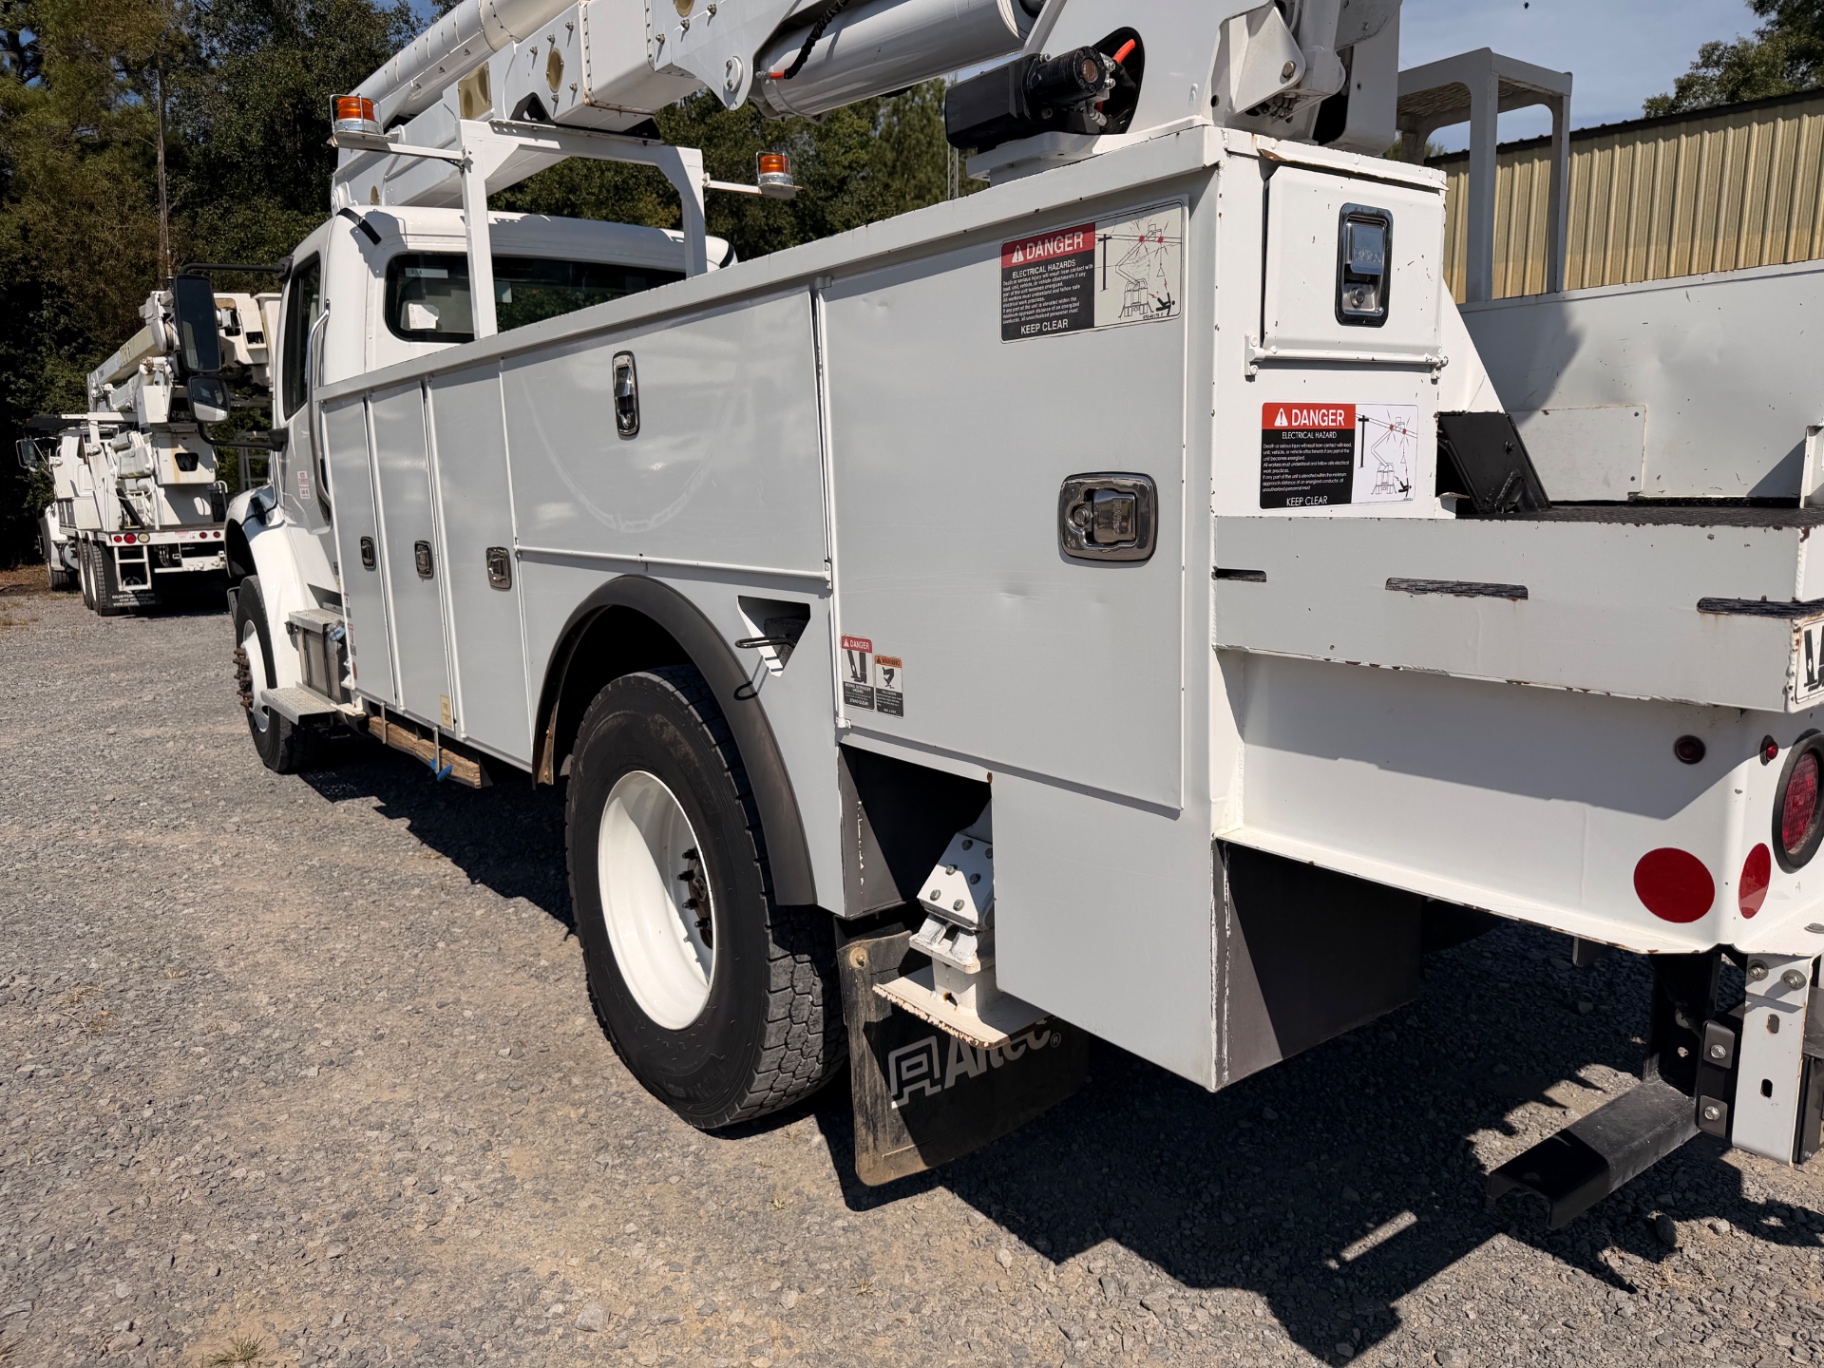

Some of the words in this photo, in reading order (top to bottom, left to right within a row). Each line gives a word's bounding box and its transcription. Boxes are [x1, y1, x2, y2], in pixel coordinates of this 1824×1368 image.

[1027, 232, 1084, 260] DANGER
[1012, 266, 1046, 278] ELECTRICAL
[1048, 259, 1076, 272] HAZARDS
[1020, 322, 1040, 334] KEEP
[1042, 318, 1068, 331] CLEAR
[1292, 409, 1344, 426] DANGER
[1286, 498, 1303, 506] KEEP
[1304, 496, 1328, 505] CLEAR
[850, 640, 870, 650] DANGER
